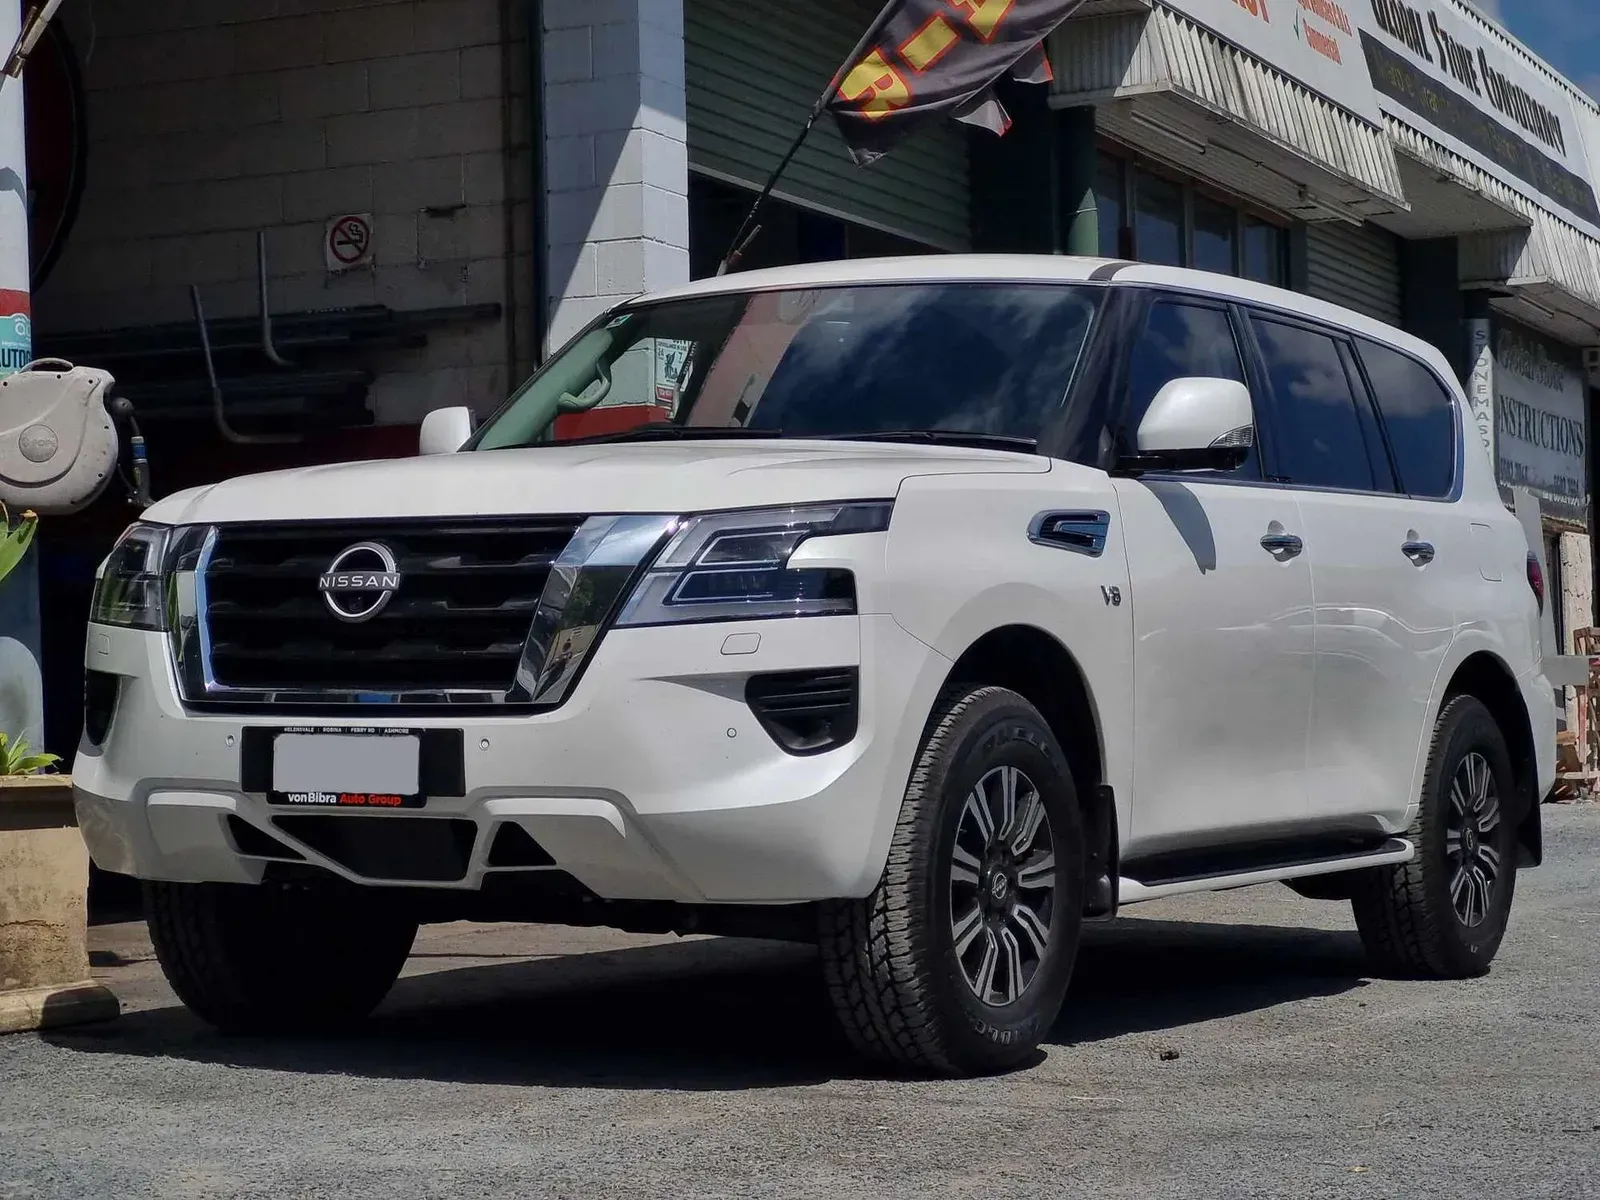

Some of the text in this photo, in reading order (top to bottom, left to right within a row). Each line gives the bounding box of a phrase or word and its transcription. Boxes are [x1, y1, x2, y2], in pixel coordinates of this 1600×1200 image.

[319, 575, 398, 588] NISSAN
[1101, 584, 1122, 607] V8
[340, 793, 366, 804] Auto
[368, 794, 402, 806] Group
